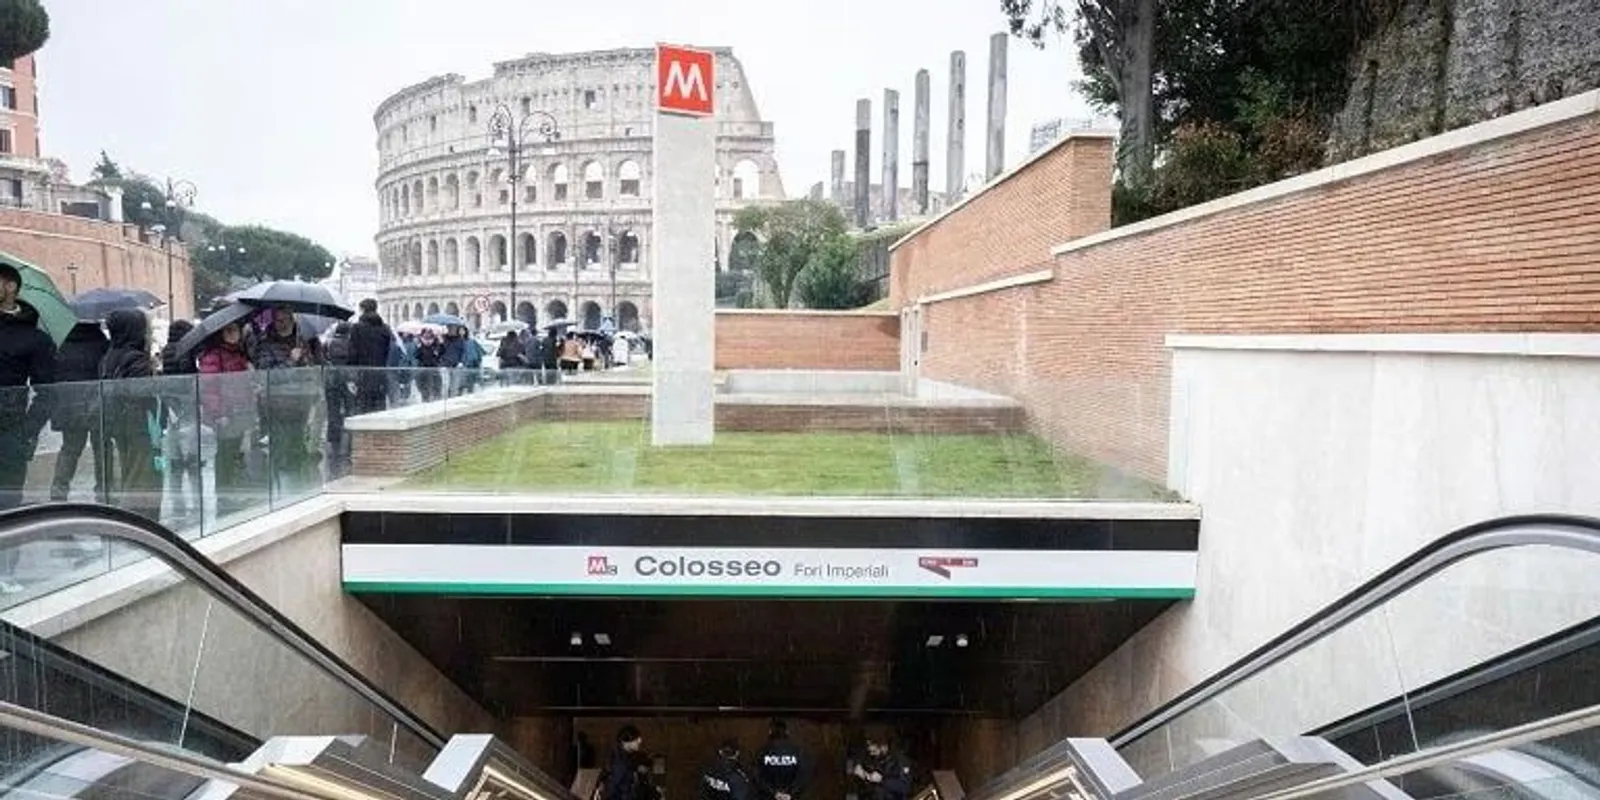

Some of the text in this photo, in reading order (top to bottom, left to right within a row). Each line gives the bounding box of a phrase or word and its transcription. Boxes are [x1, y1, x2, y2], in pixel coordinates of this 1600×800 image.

[662, 60, 708, 101] M
[635, 556, 781, 576] Colosseo
[794, 563, 822, 577] Fori
[826, 563, 889, 579] Imperiali
[764, 755, 797, 766] POLIZIA
